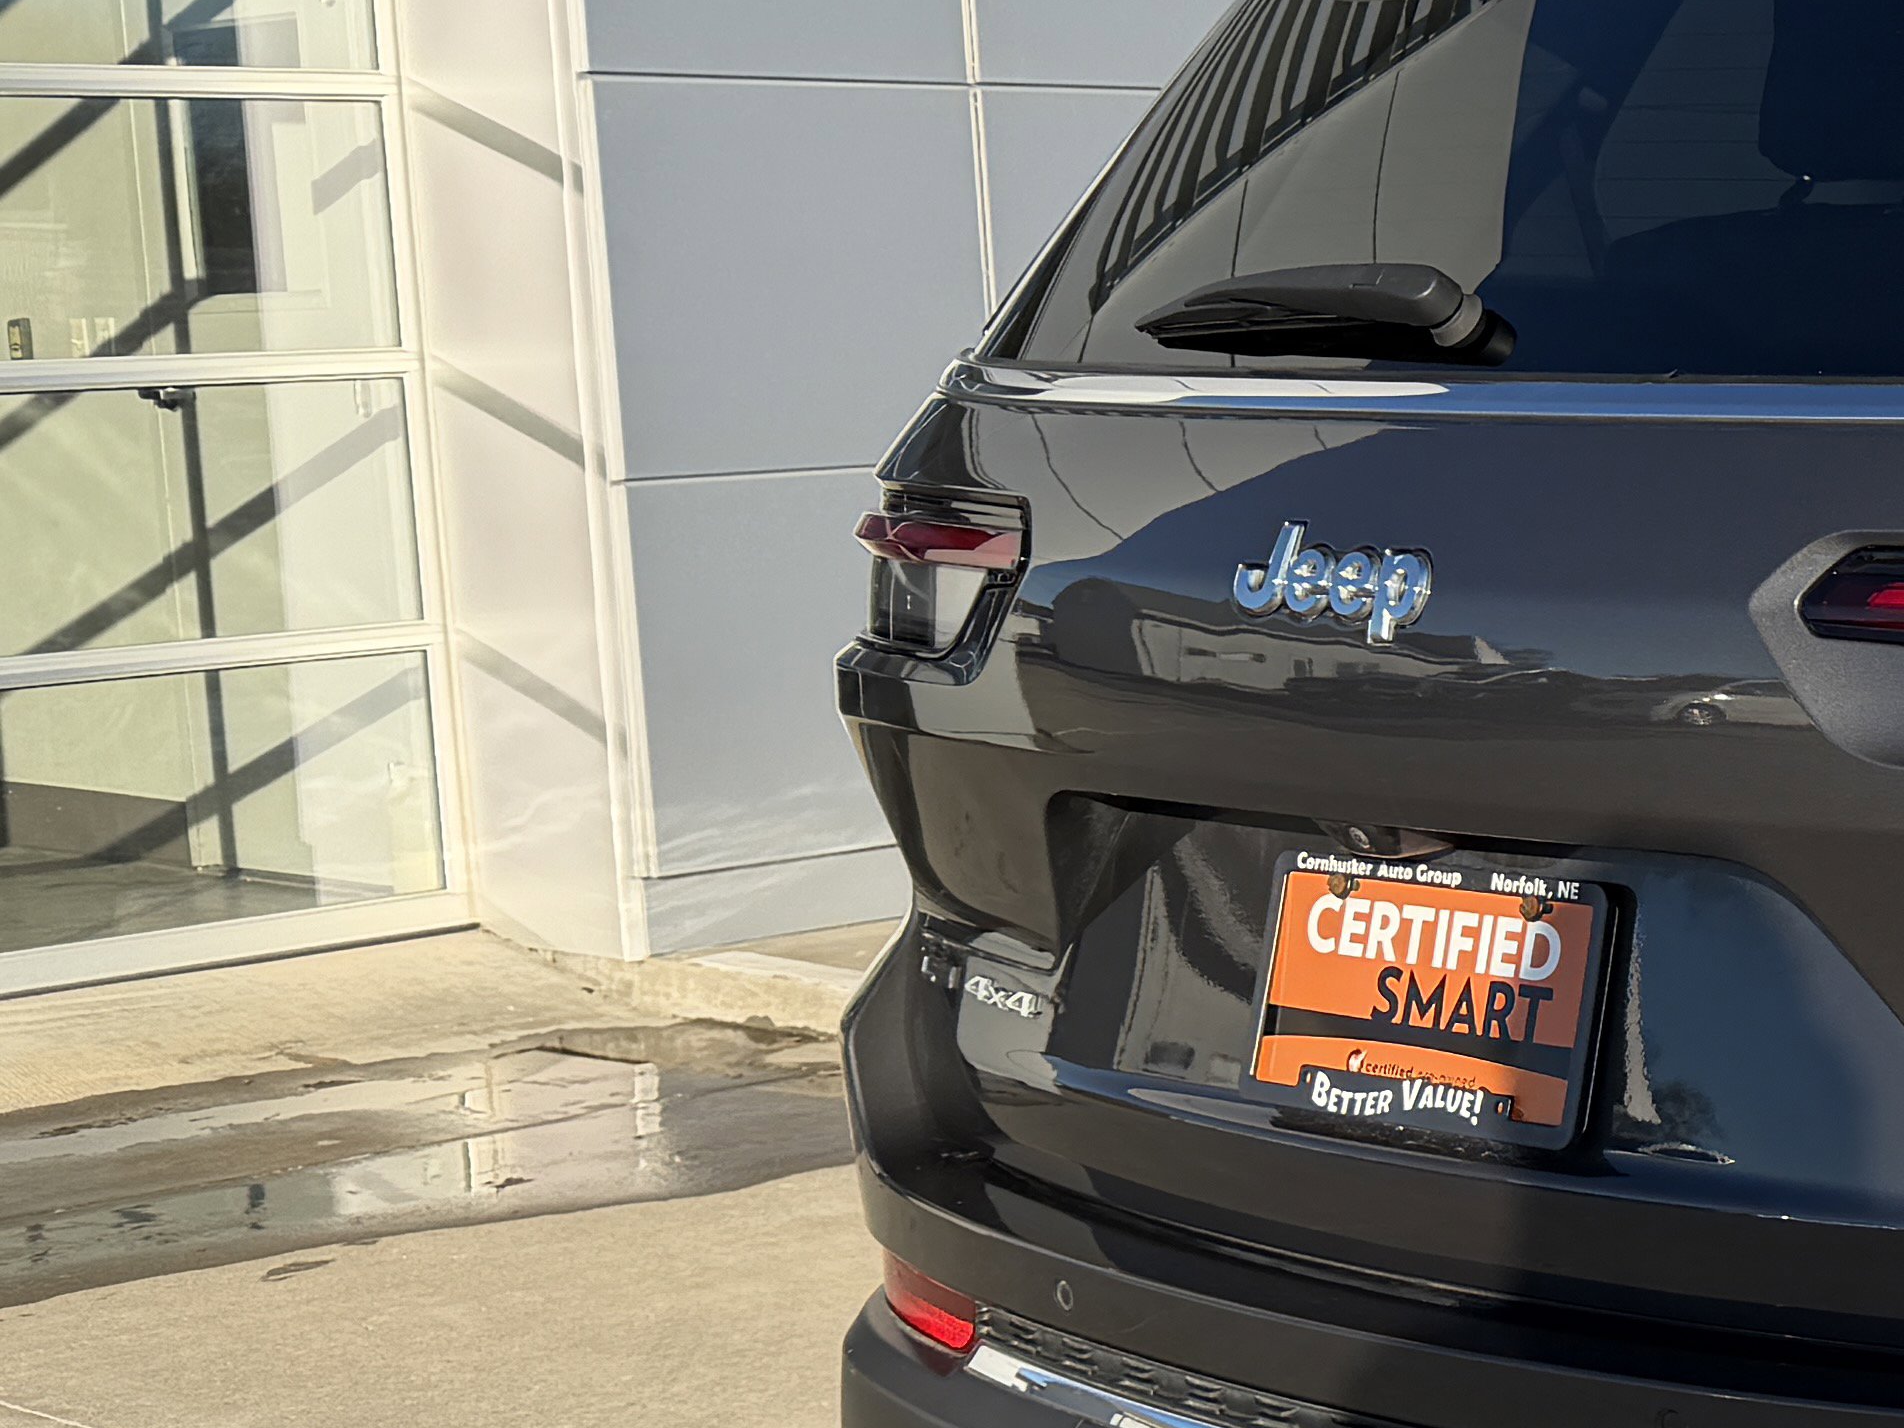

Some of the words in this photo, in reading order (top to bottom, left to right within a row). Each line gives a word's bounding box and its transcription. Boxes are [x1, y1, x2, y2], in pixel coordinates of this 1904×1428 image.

[1233, 520, 1433, 647] Jeep
[1297, 851, 1374, 876] Cornhusker
[1377, 862, 1413, 880] Auto
[1416, 864, 1463, 888] Group
[1490, 872, 1553, 899] Norfolk,
[1557, 880, 1580, 900] NE
[1307, 894, 1562, 981] CERTIFIED
[1371, 965, 1554, 1044] SMART
[1365, 1062, 1414, 1080] certified
